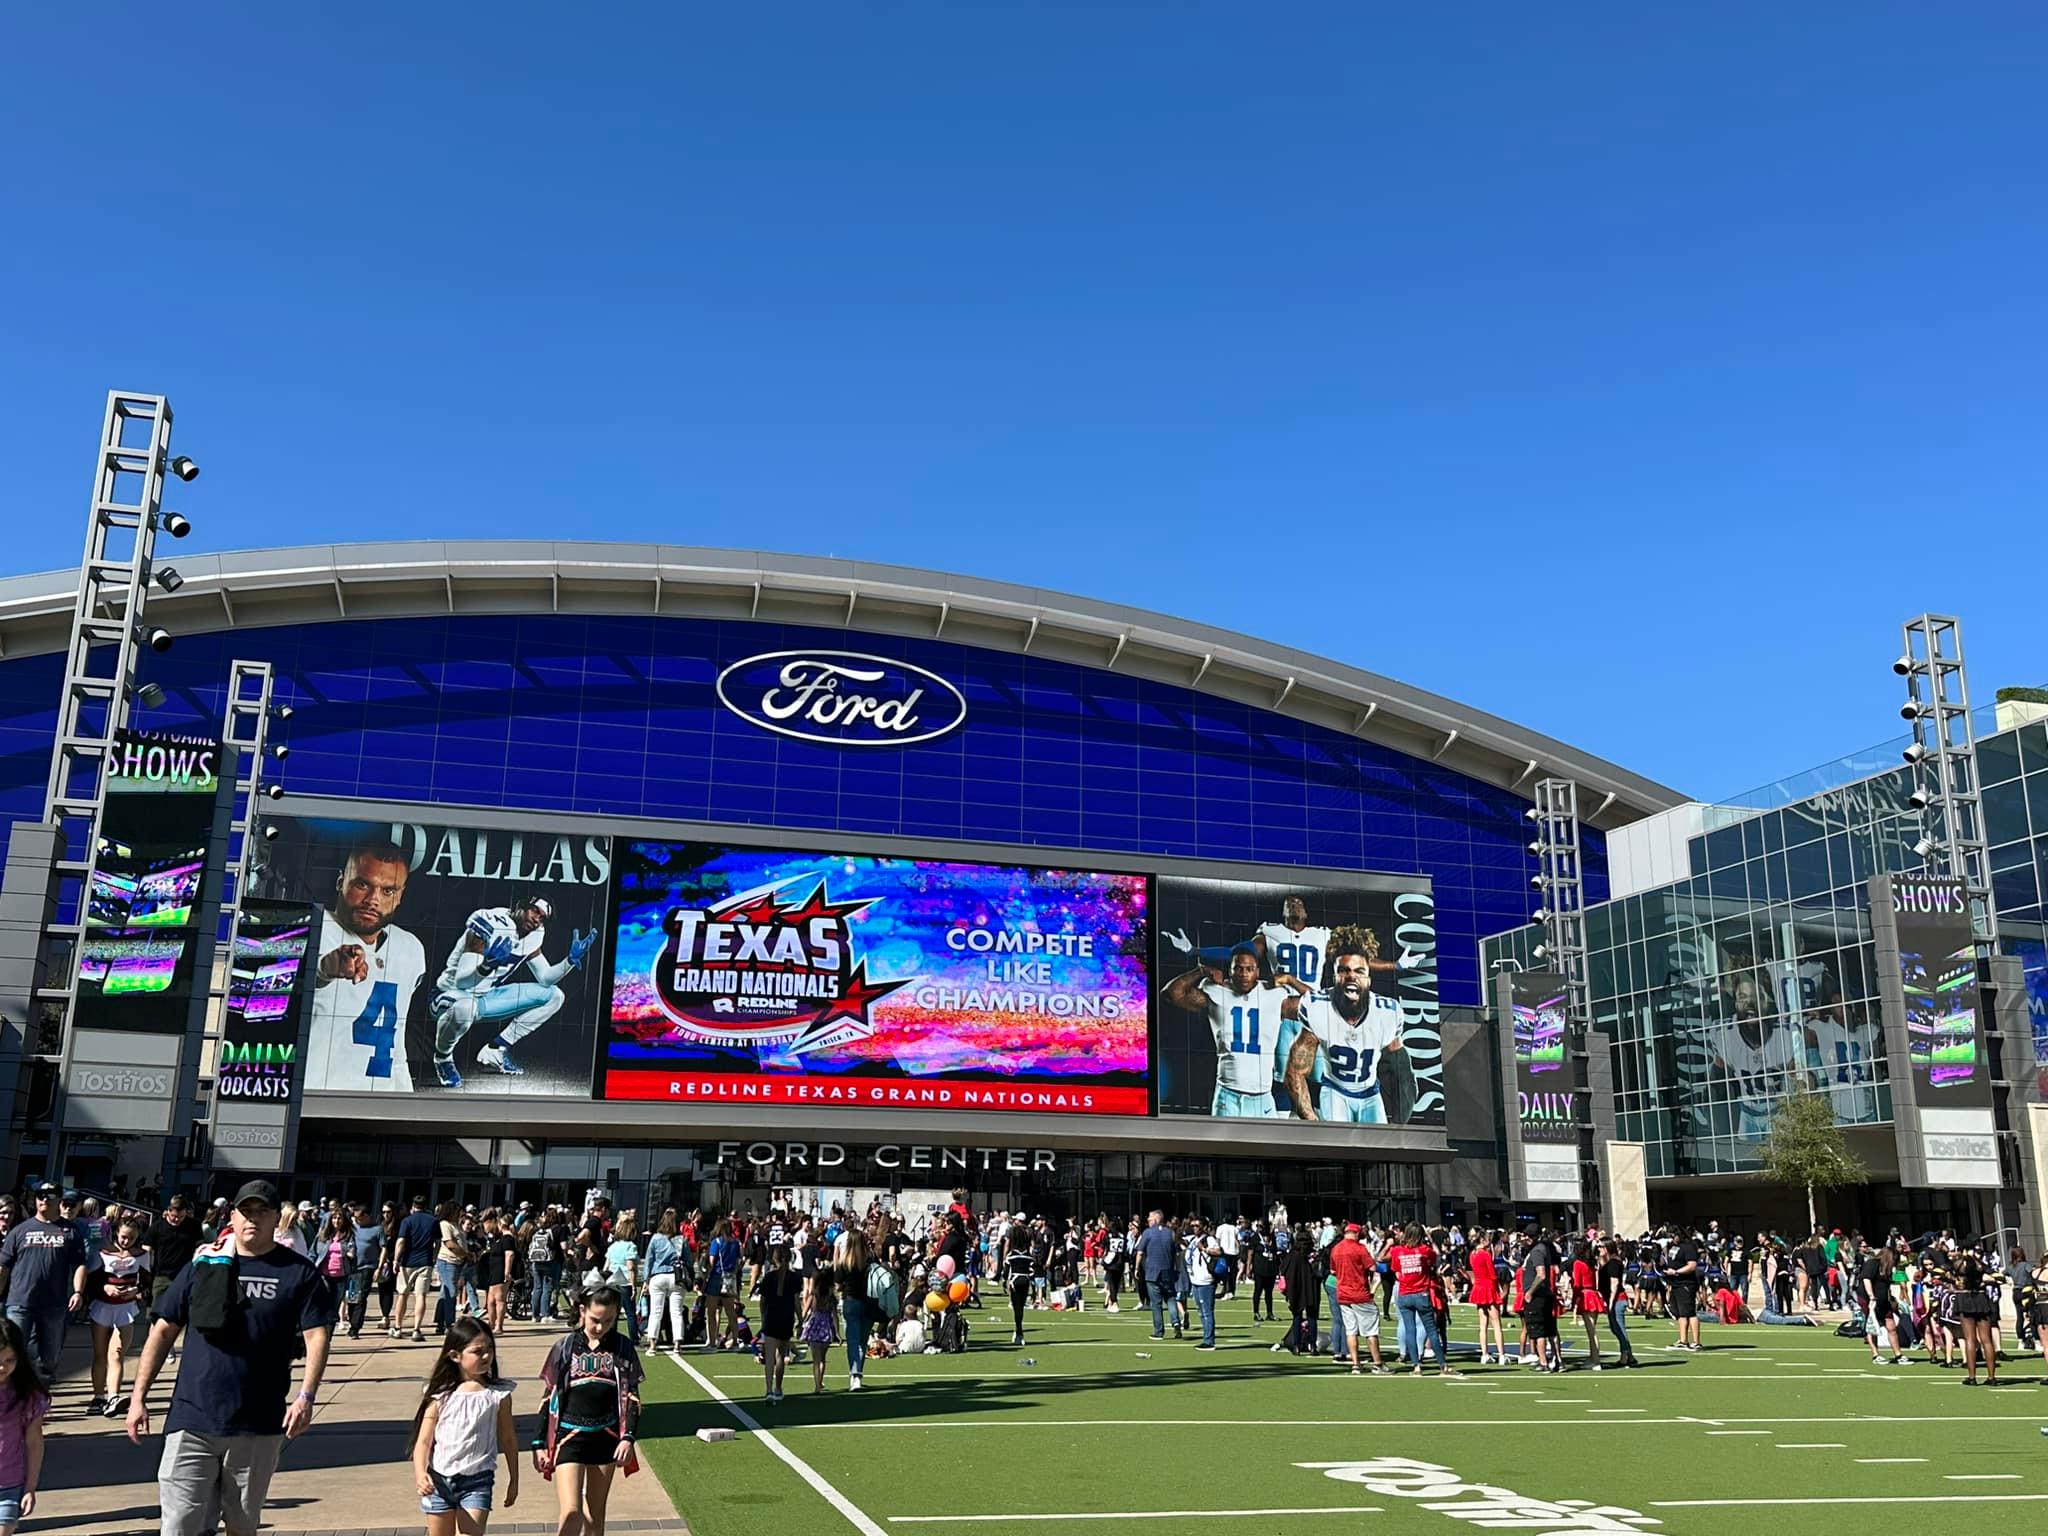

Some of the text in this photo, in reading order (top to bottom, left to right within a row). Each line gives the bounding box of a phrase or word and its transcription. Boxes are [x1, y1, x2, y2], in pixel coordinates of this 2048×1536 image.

[762, 660, 924, 731] Ford
[391, 822, 609, 886] DALLAS
[675, 910, 841, 971] TEXAS
[946, 928, 1093, 957] COMPETE
[673, 968, 839, 998] GRAND NATIONALS
[987, 959, 1051, 984] LIKE
[736, 1008, 798, 1016] CHAMPIONSHIPS
[737, 996, 798, 1009] REDLINE
[916, 987, 1121, 1018] CHAMPIONS
[1393, 893, 1446, 1113] COWBOYS
[353, 981, 399, 1078] 4
[699, 1034, 734, 1048] CENTER
[737, 1038, 748, 1048] AT
[752, 1037, 767, 1047] THE
[770, 1034, 793, 1046] STAR
[1230, 1006, 1261, 1055] 11
[220, 1040, 294, 1074] DAILY
[1328, 1044, 1374, 1083] 21
[669, 1081, 1094, 1107] REDLINE TEXAS GRAND NATIONALS
[1518, 1091, 1574, 1120] DAILY
[717, 1142, 1057, 1171] FORD CENTER
[25, 1235, 65, 1245] TEXAS
